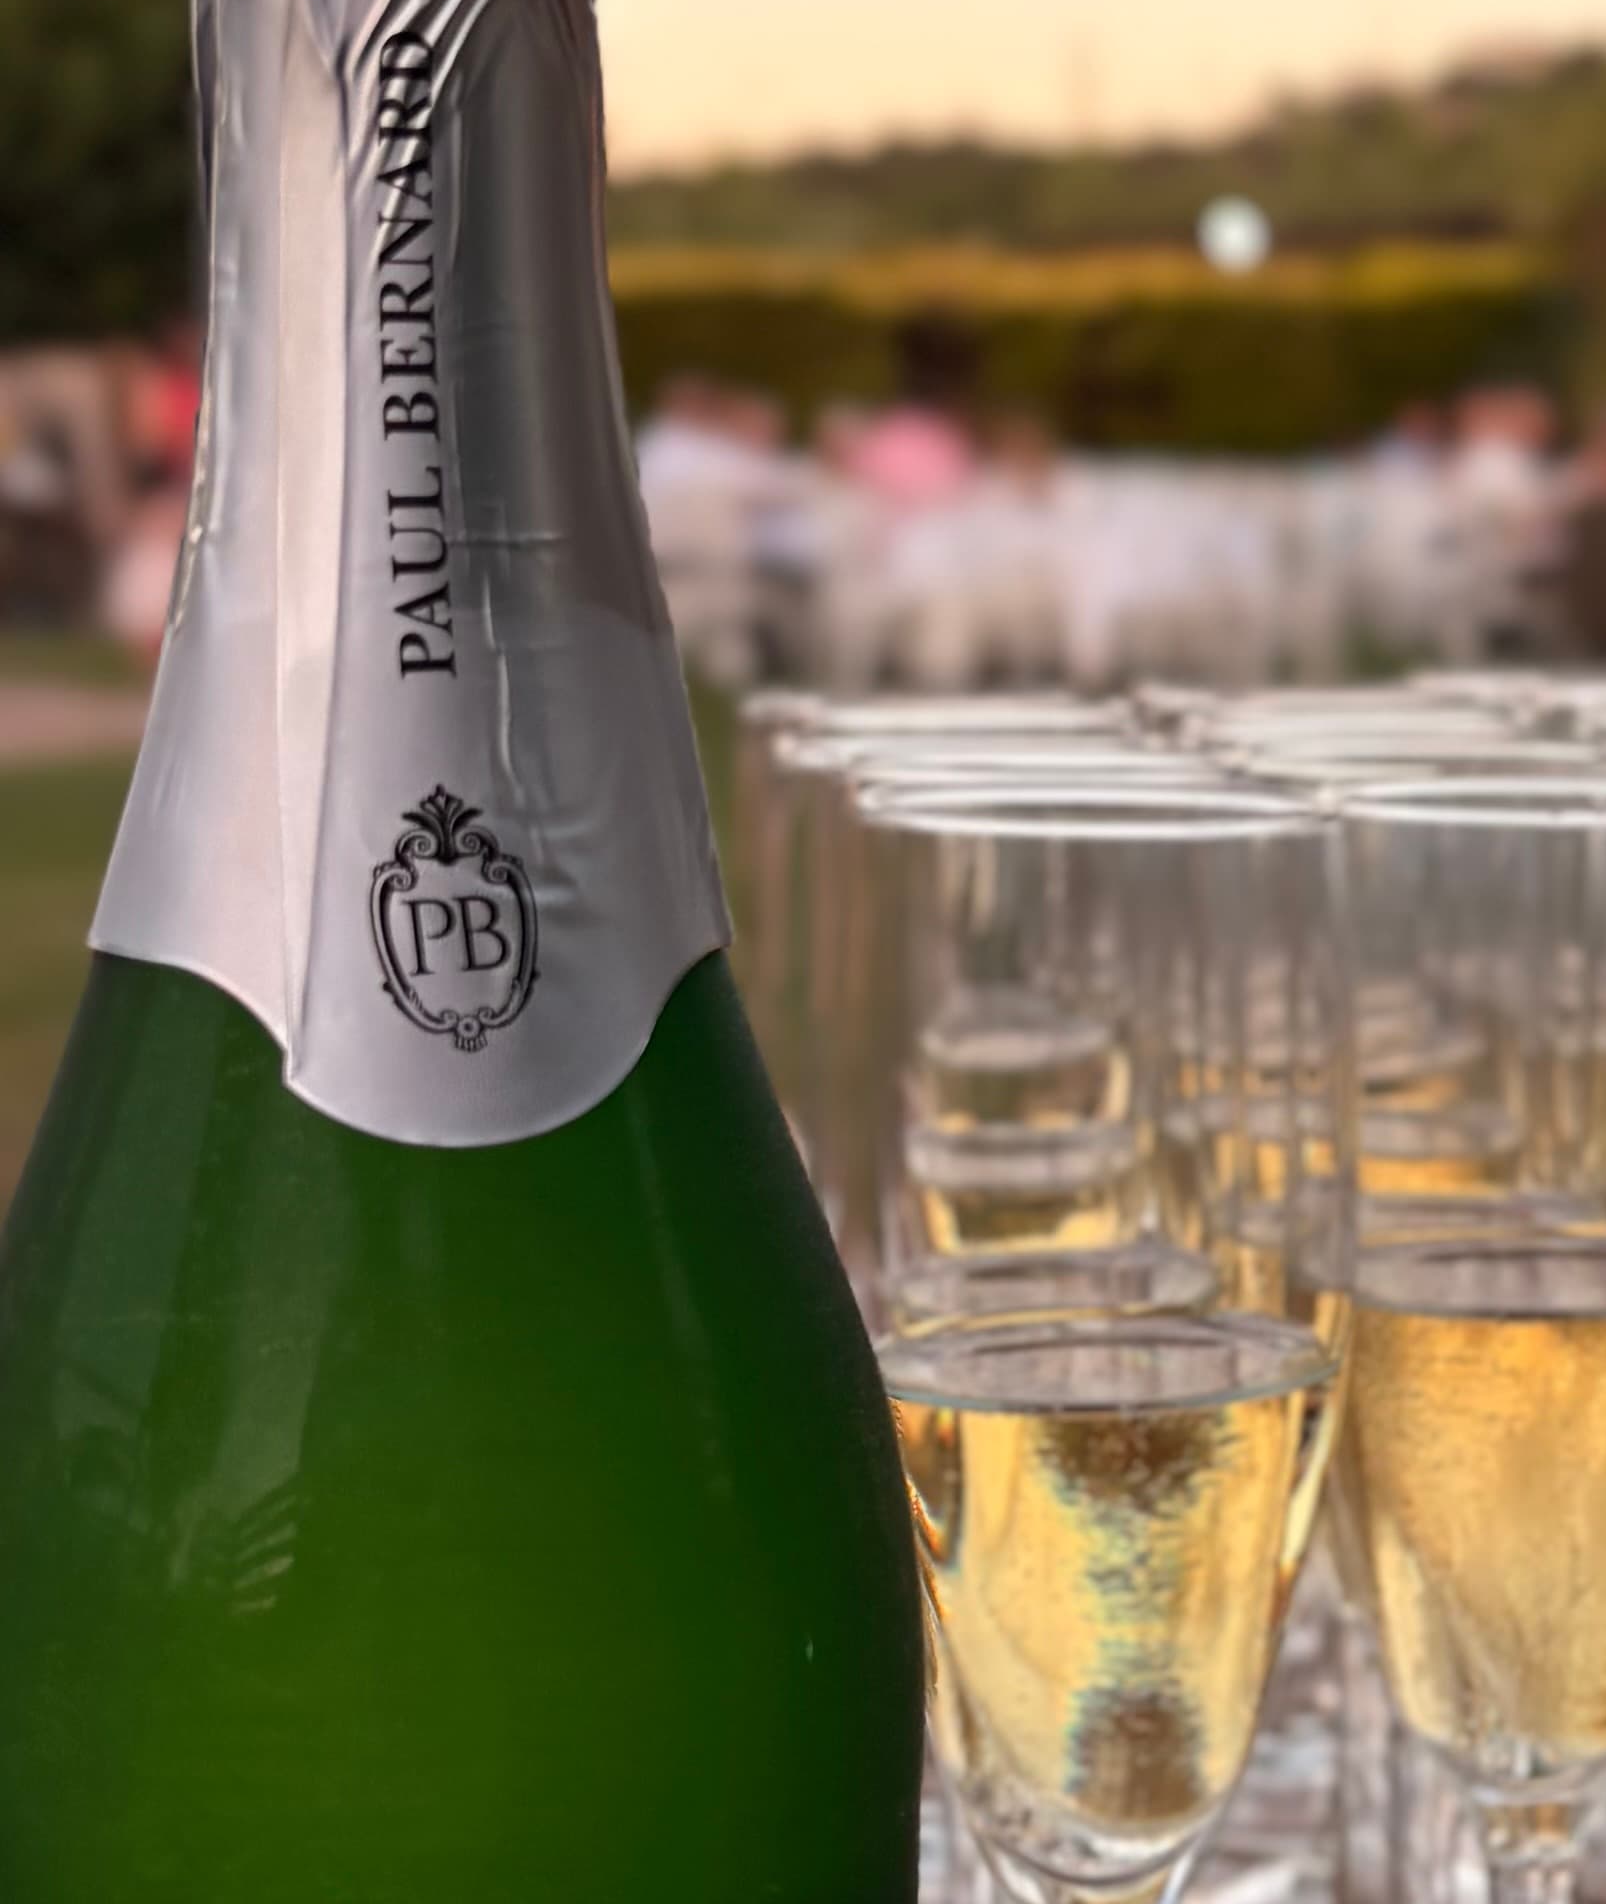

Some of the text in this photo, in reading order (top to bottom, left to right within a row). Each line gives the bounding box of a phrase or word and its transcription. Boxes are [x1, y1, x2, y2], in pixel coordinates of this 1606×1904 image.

[376, 30, 457, 679] PAUL BERNARD
[402, 894, 512, 976] PB
